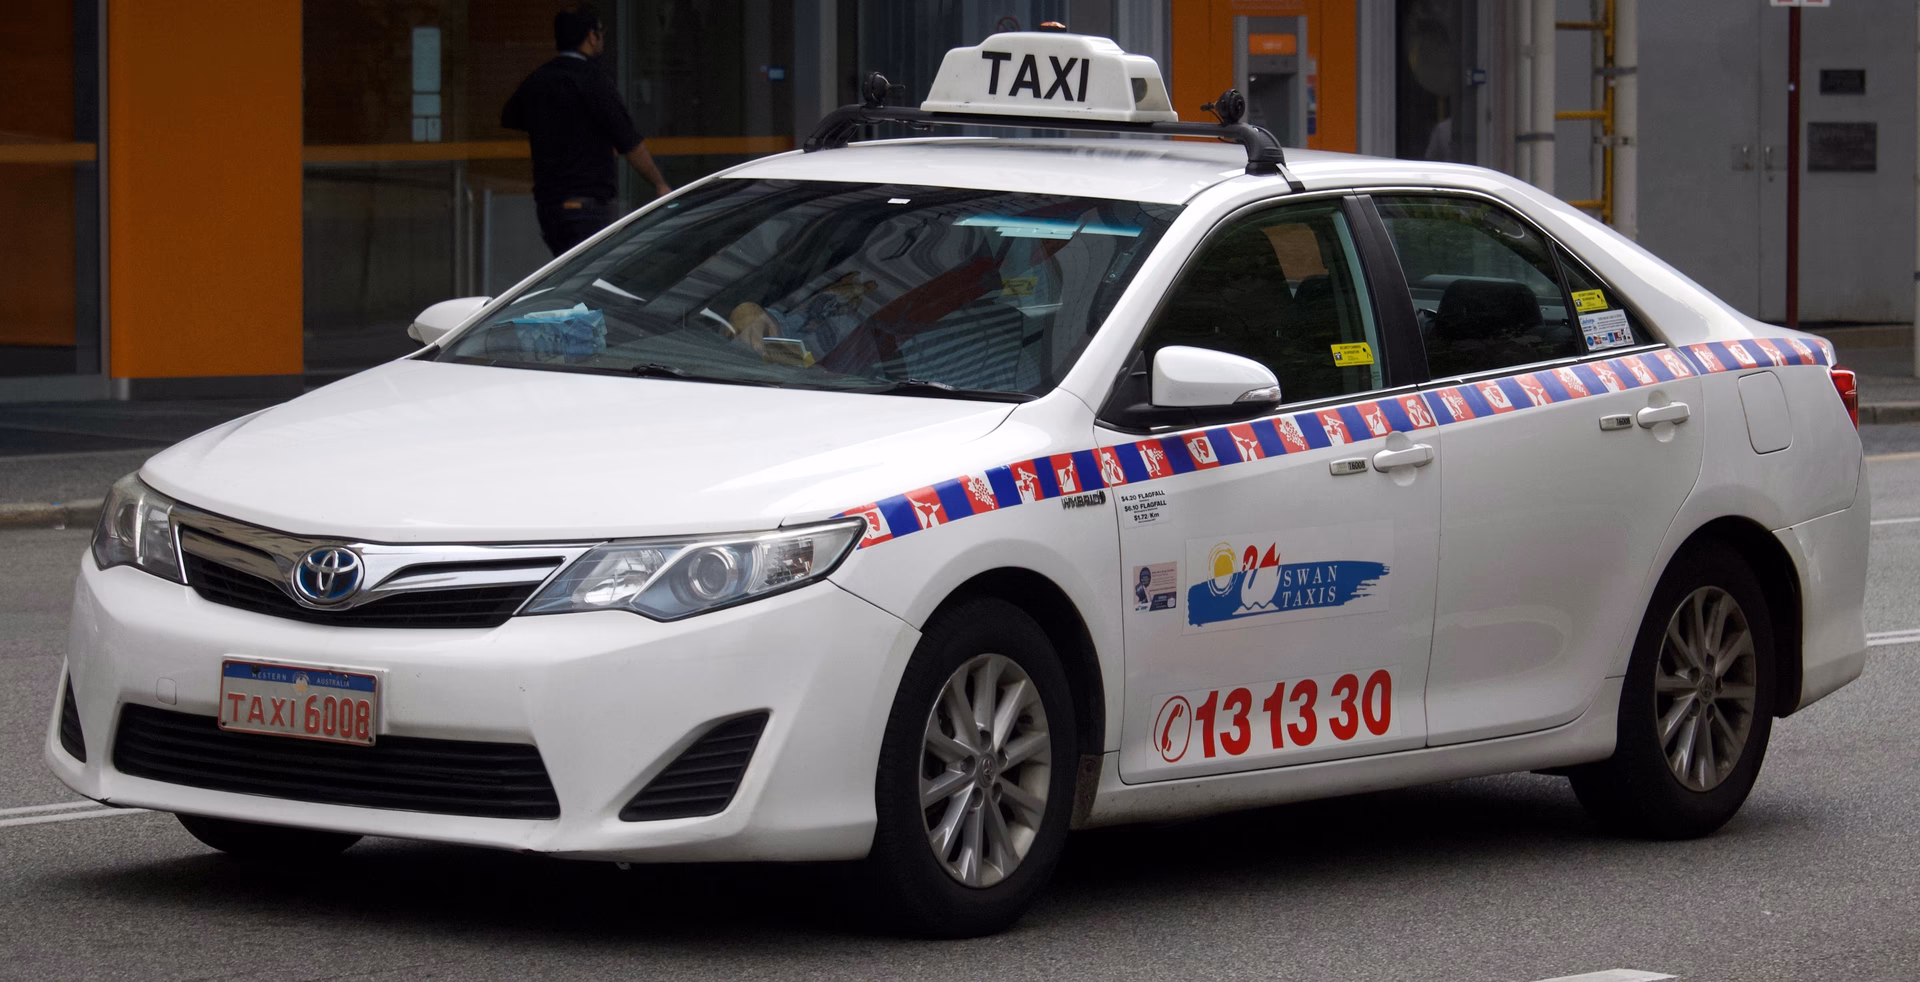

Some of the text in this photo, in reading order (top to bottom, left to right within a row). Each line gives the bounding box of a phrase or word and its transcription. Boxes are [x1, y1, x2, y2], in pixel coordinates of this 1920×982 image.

[982, 51, 1090, 102] TAXI
[1138, 490, 1165, 499] FLAGFALL
[1140, 500, 1167, 509] FLAGFALL
[1283, 565, 1338, 587] SWAN
[1282, 586, 1336, 608] TAXIS
[252, 671, 350, 688] WESTERN AUSTRALIA
[228, 692, 370, 739] TAXI 6008
[1195, 669, 1392, 759] 13 13 30
